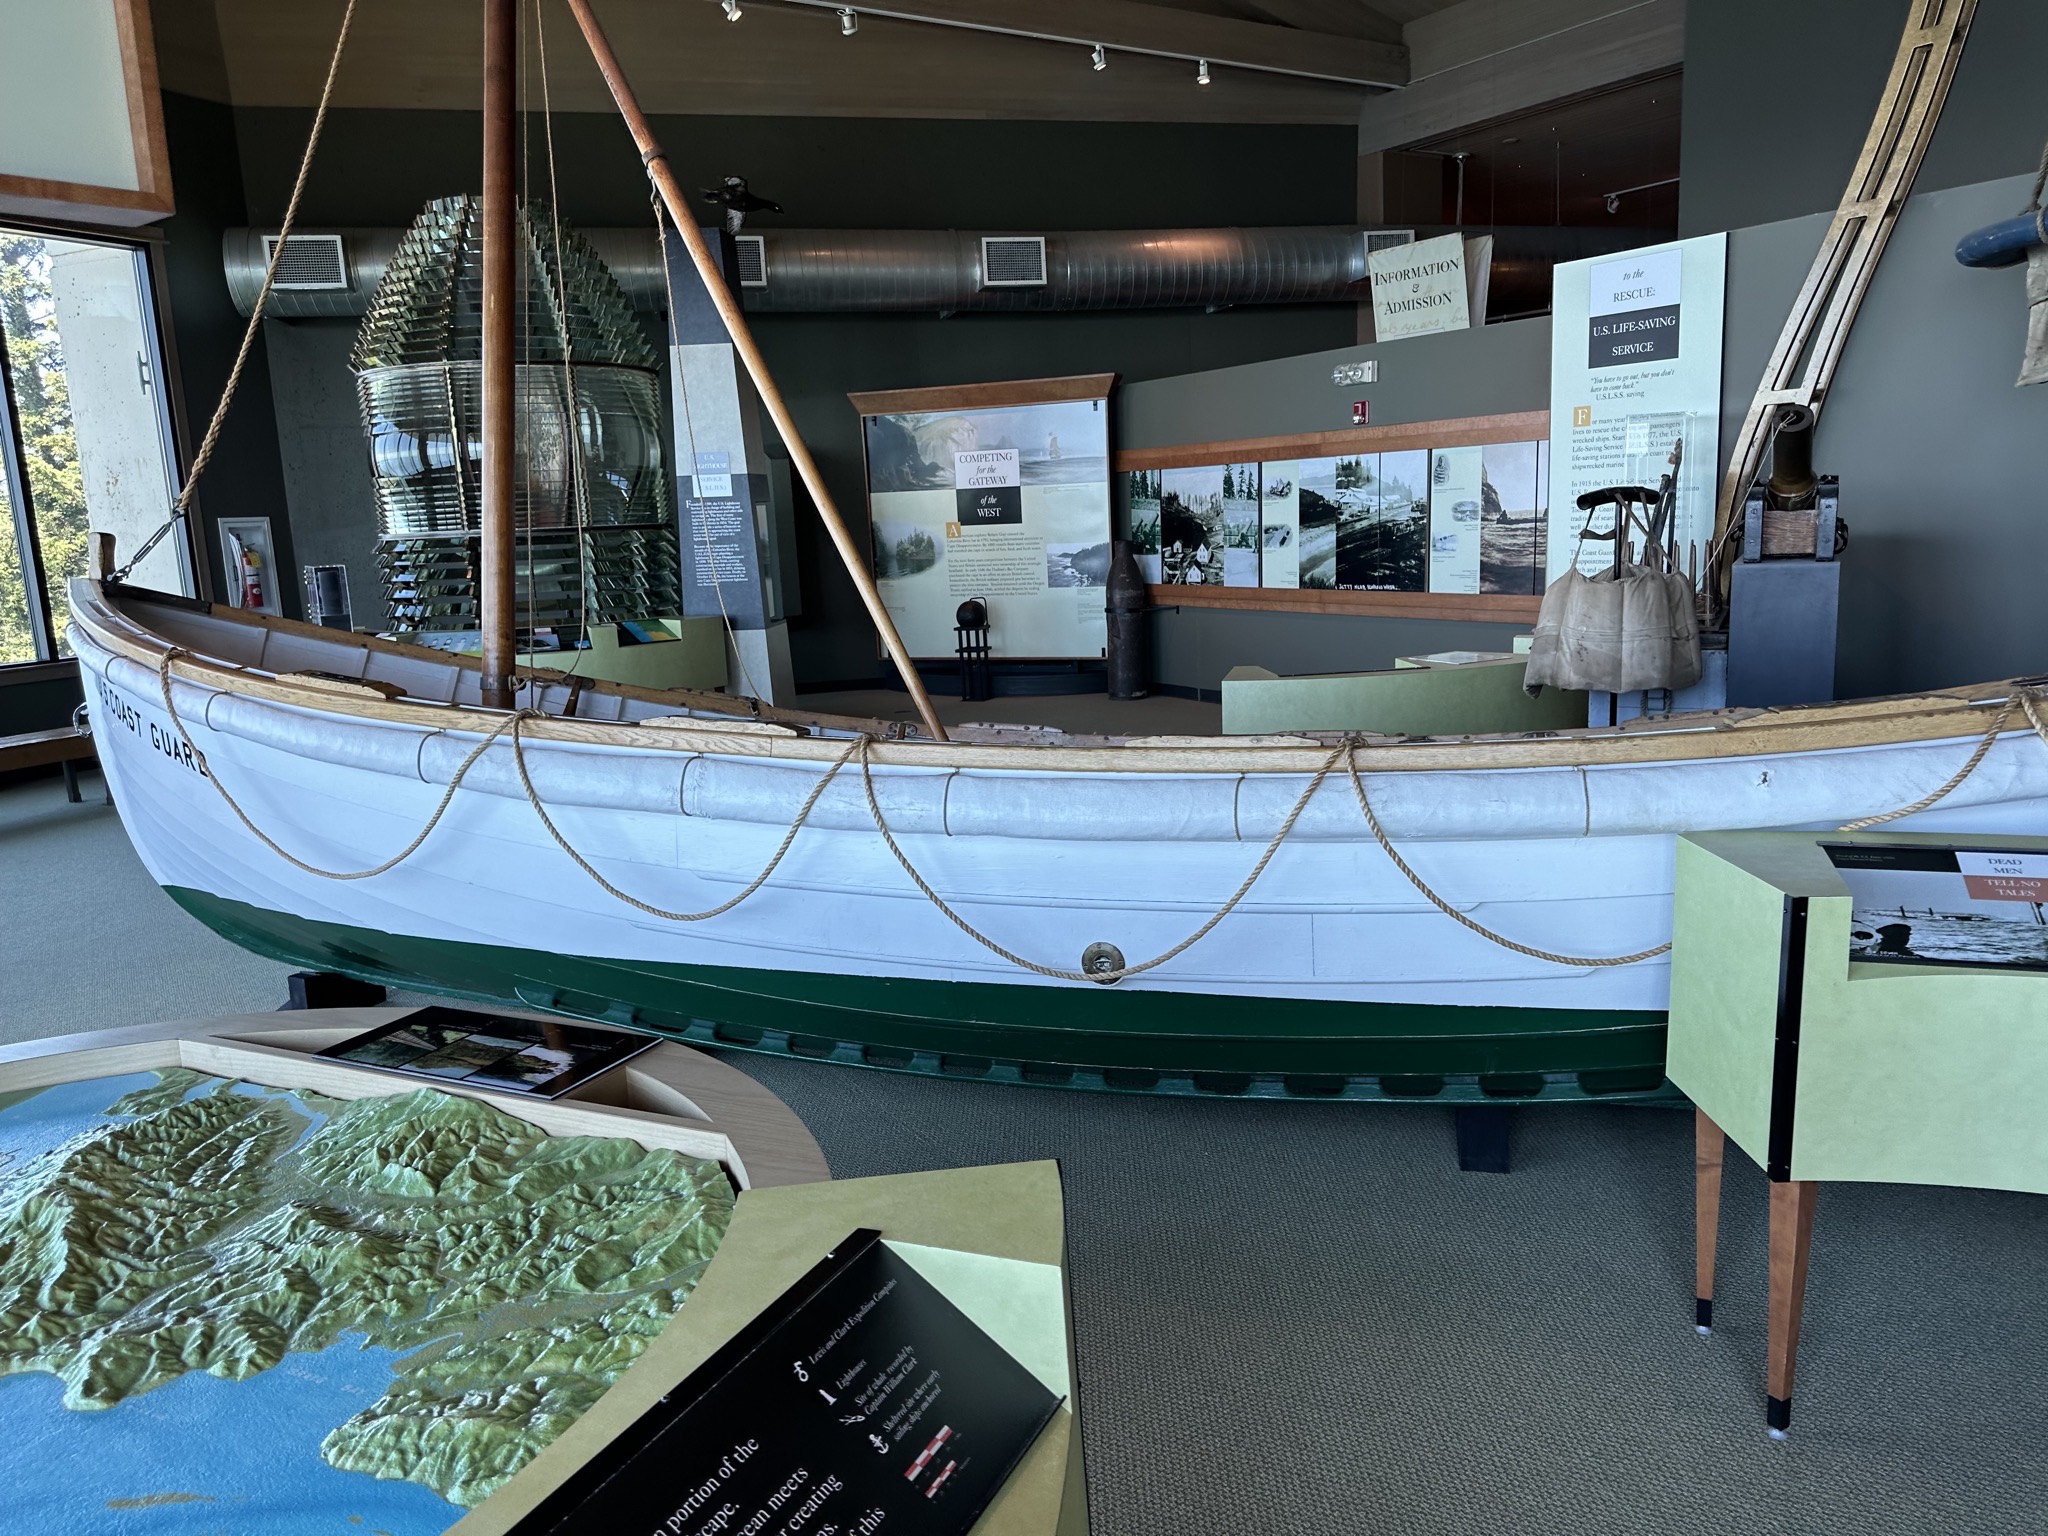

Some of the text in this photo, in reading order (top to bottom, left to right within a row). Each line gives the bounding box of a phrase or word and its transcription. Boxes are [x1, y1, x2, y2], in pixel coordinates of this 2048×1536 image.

[1374, 258, 1460, 286] INFORMATION
[1622, 268, 1644, 280] to the
[1411, 283, 1420, 293] &
[1613, 287, 1656, 302] RESCUE:
[1384, 292, 1452, 315] ADMISSION
[1593, 316, 1676, 337] U.S. LIFE-SAVING
[1612, 342, 1654, 356] SERVICE
[959, 452, 1012, 464] COMPETING
[1572, 462, 1604, 471] shipwrecked
[968, 476, 1008, 486] GATEWAY
[975, 465, 996, 476] for the
[980, 495, 997, 506] of the
[977, 507, 1002, 517] WEST
[110, 688, 141, 738] COAST
[150, 722, 208, 778] GUARD
[1988, 858, 2022, 866] DEAD
[1984, 879, 2041, 888] TELL NO
[1995, 889, 2036, 897] TALES
[808, 1278, 897, 1364] Lewis and Clark Expedition Campsites
[836, 1359, 867, 1390] Lighthouses
[854, 1345, 914, 1406] Site of whale recorded by
[864, 1356, 918, 1415] Captain William Clark
[883, 1370, 940, 1432] Sheltered site where early
[894, 1384, 942, 1441] sailing ships anchored
[666, 1438, 759, 1535] portion of the
[736, 1467, 808, 1536] cean meets
[788, 1474, 844, 1531] creating
[686, 1501, 740, 1536] cape.
[859, 1506, 886, 1535] this
